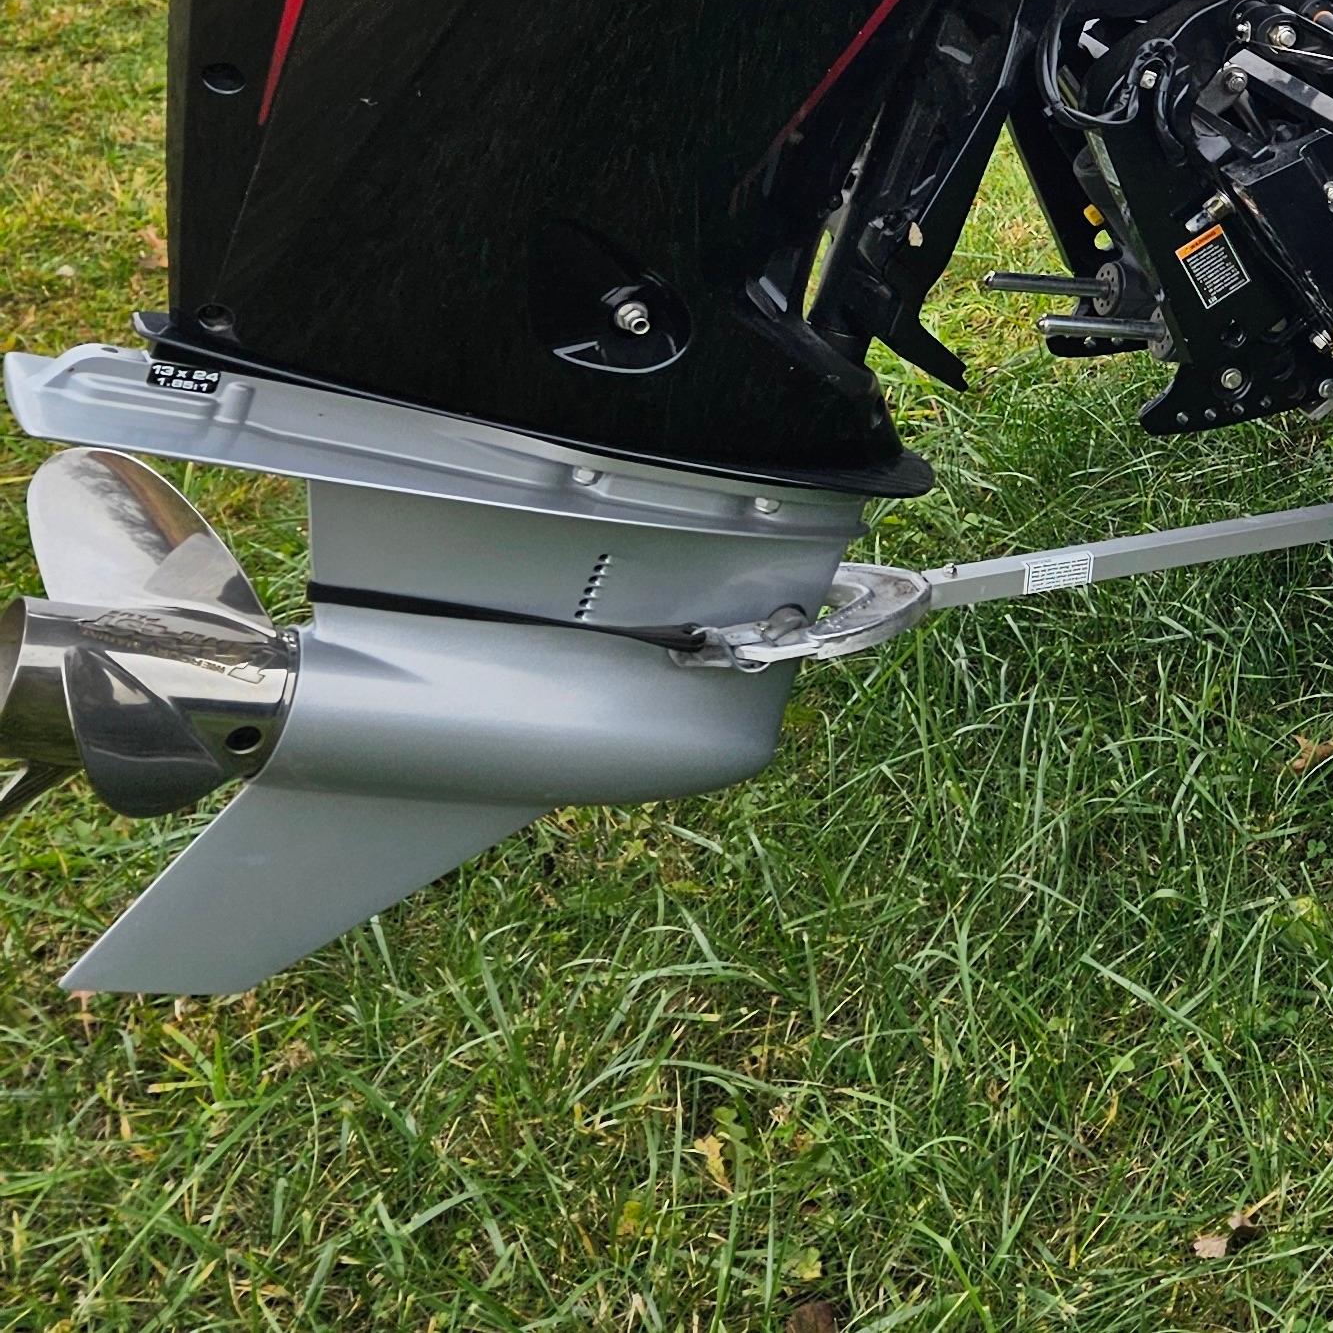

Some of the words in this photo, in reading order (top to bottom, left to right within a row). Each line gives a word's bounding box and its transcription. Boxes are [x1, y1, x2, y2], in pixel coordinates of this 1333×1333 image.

[152, 365, 175, 376] 13
[176, 370, 188, 378] x
[193, 370, 219, 382] 24
